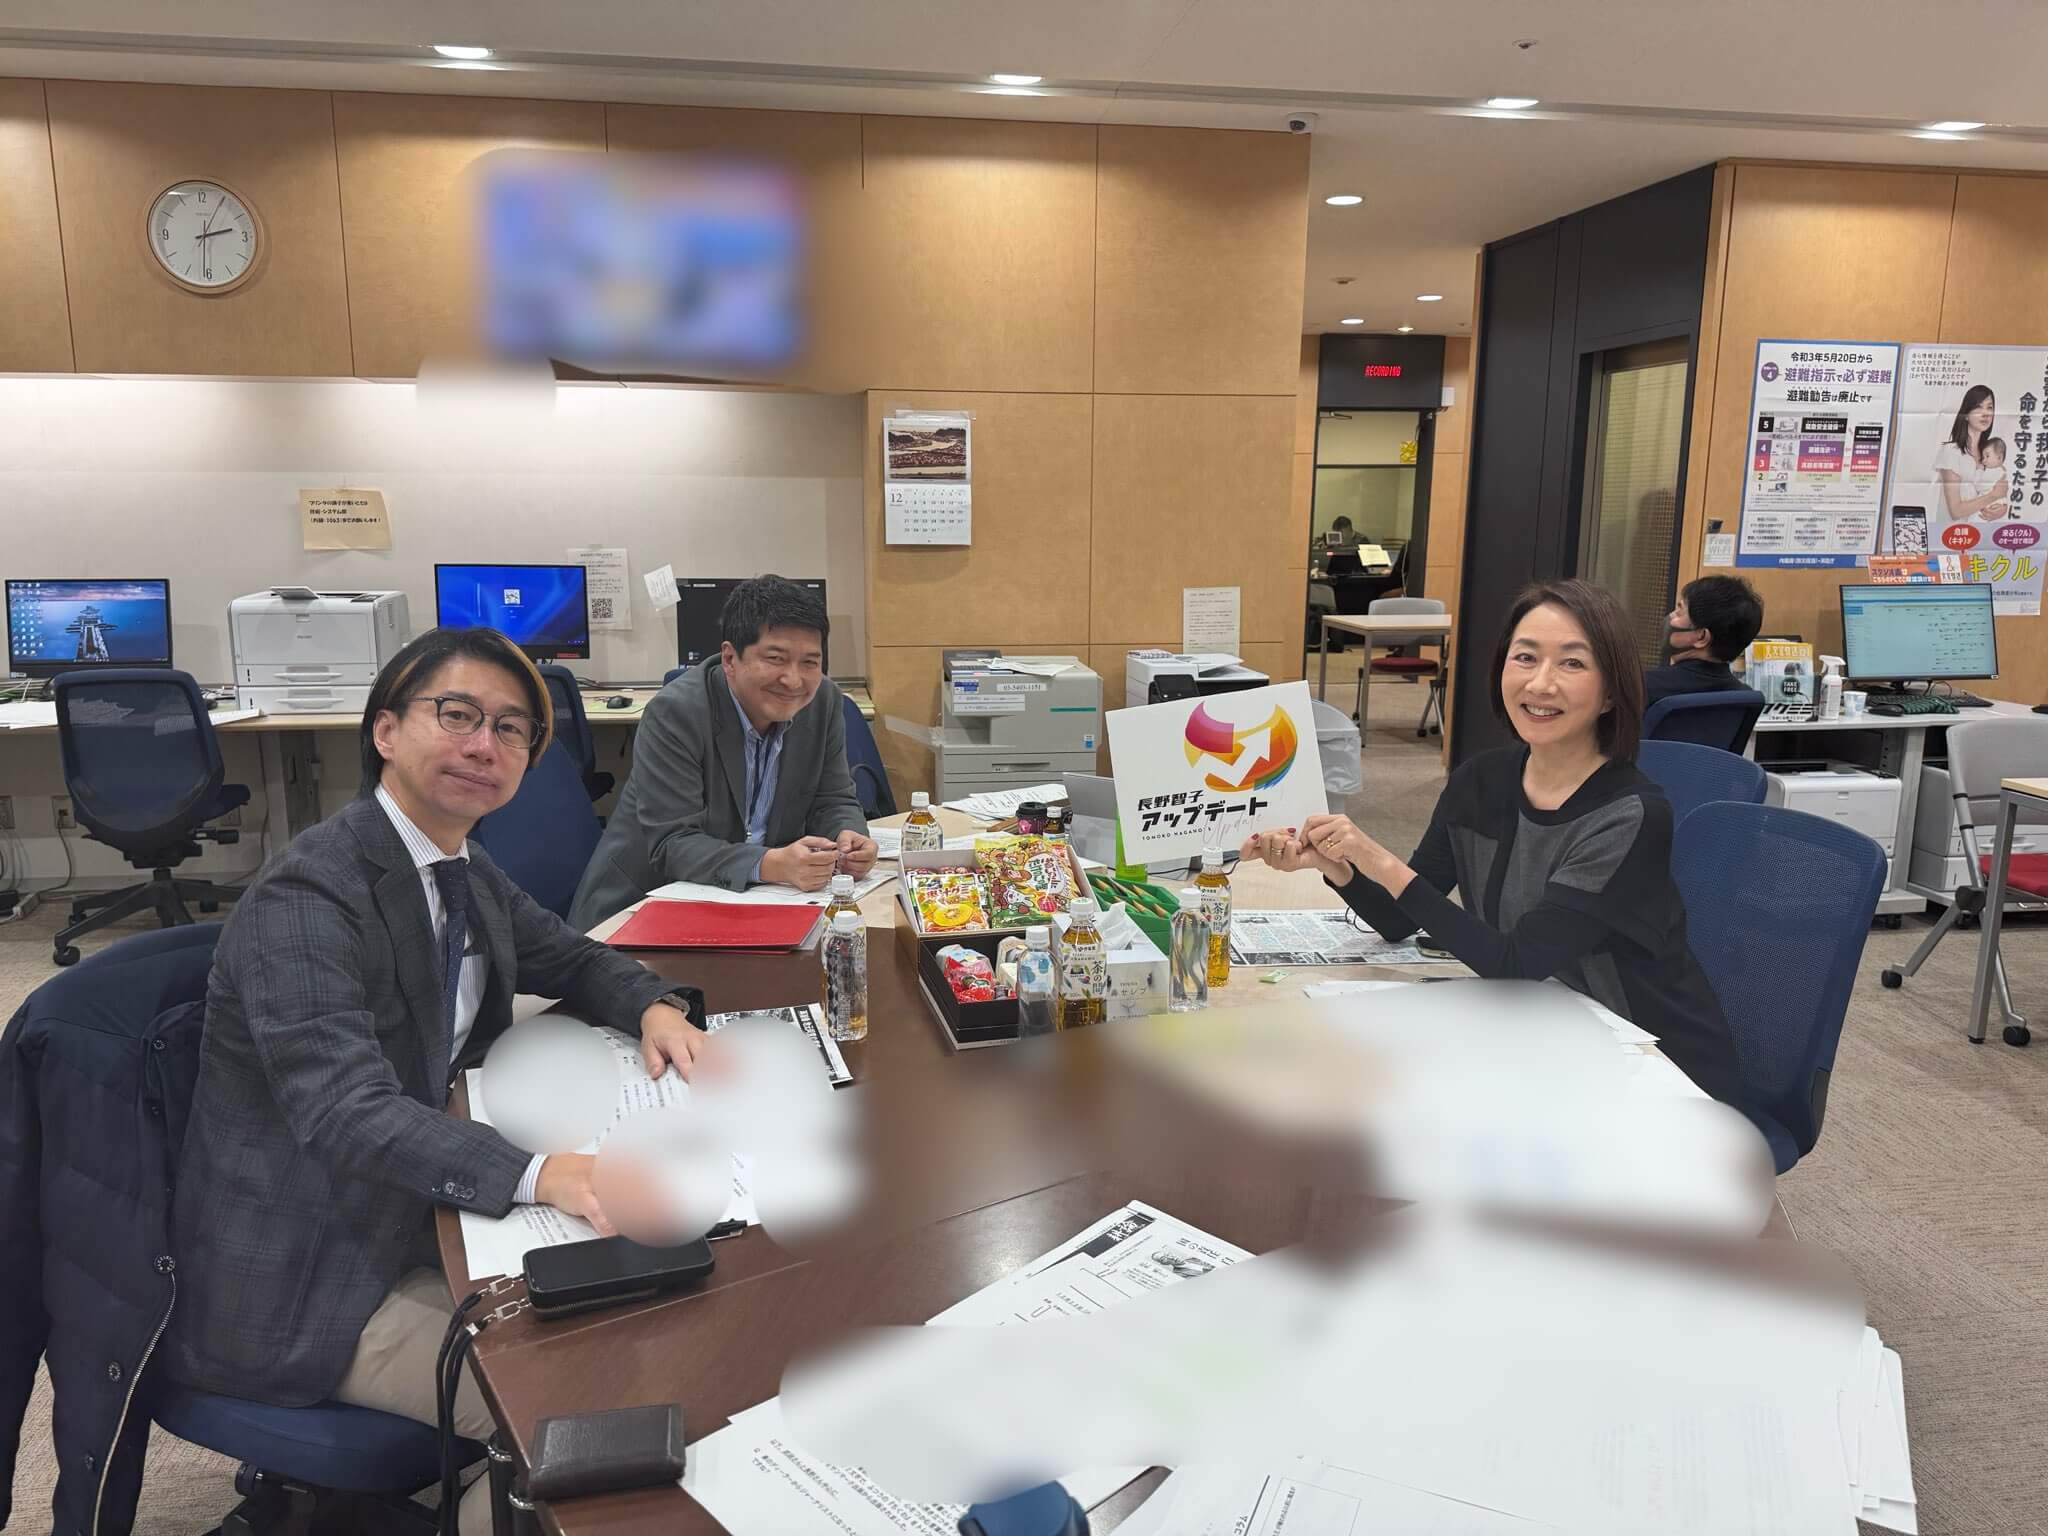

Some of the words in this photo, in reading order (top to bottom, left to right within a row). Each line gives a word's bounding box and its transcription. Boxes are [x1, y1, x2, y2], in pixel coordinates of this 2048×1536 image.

[198, 191, 206, 203] 12
[162, 228, 169, 240] 9
[241, 231, 248, 243] 3
[206, 267, 212, 279] 6
[1790, 351, 1873, 363] 令和3年5月20日から
[1364, 365, 1401, 377] RECORDING
[1784, 368, 1893, 384] 避難指示で必ず避難
[1786, 390, 1873, 403] 避難勧告は廃止です
[2008, 392, 2037, 520] 命を守るために
[890, 493, 903, 503] 12
[1968, 553, 2039, 582] キクル
[1137, 789, 1204, 811] 長野智子
[1141, 797, 1268, 831] アップデート
[1092, 960, 1105, 995] 茶の間
